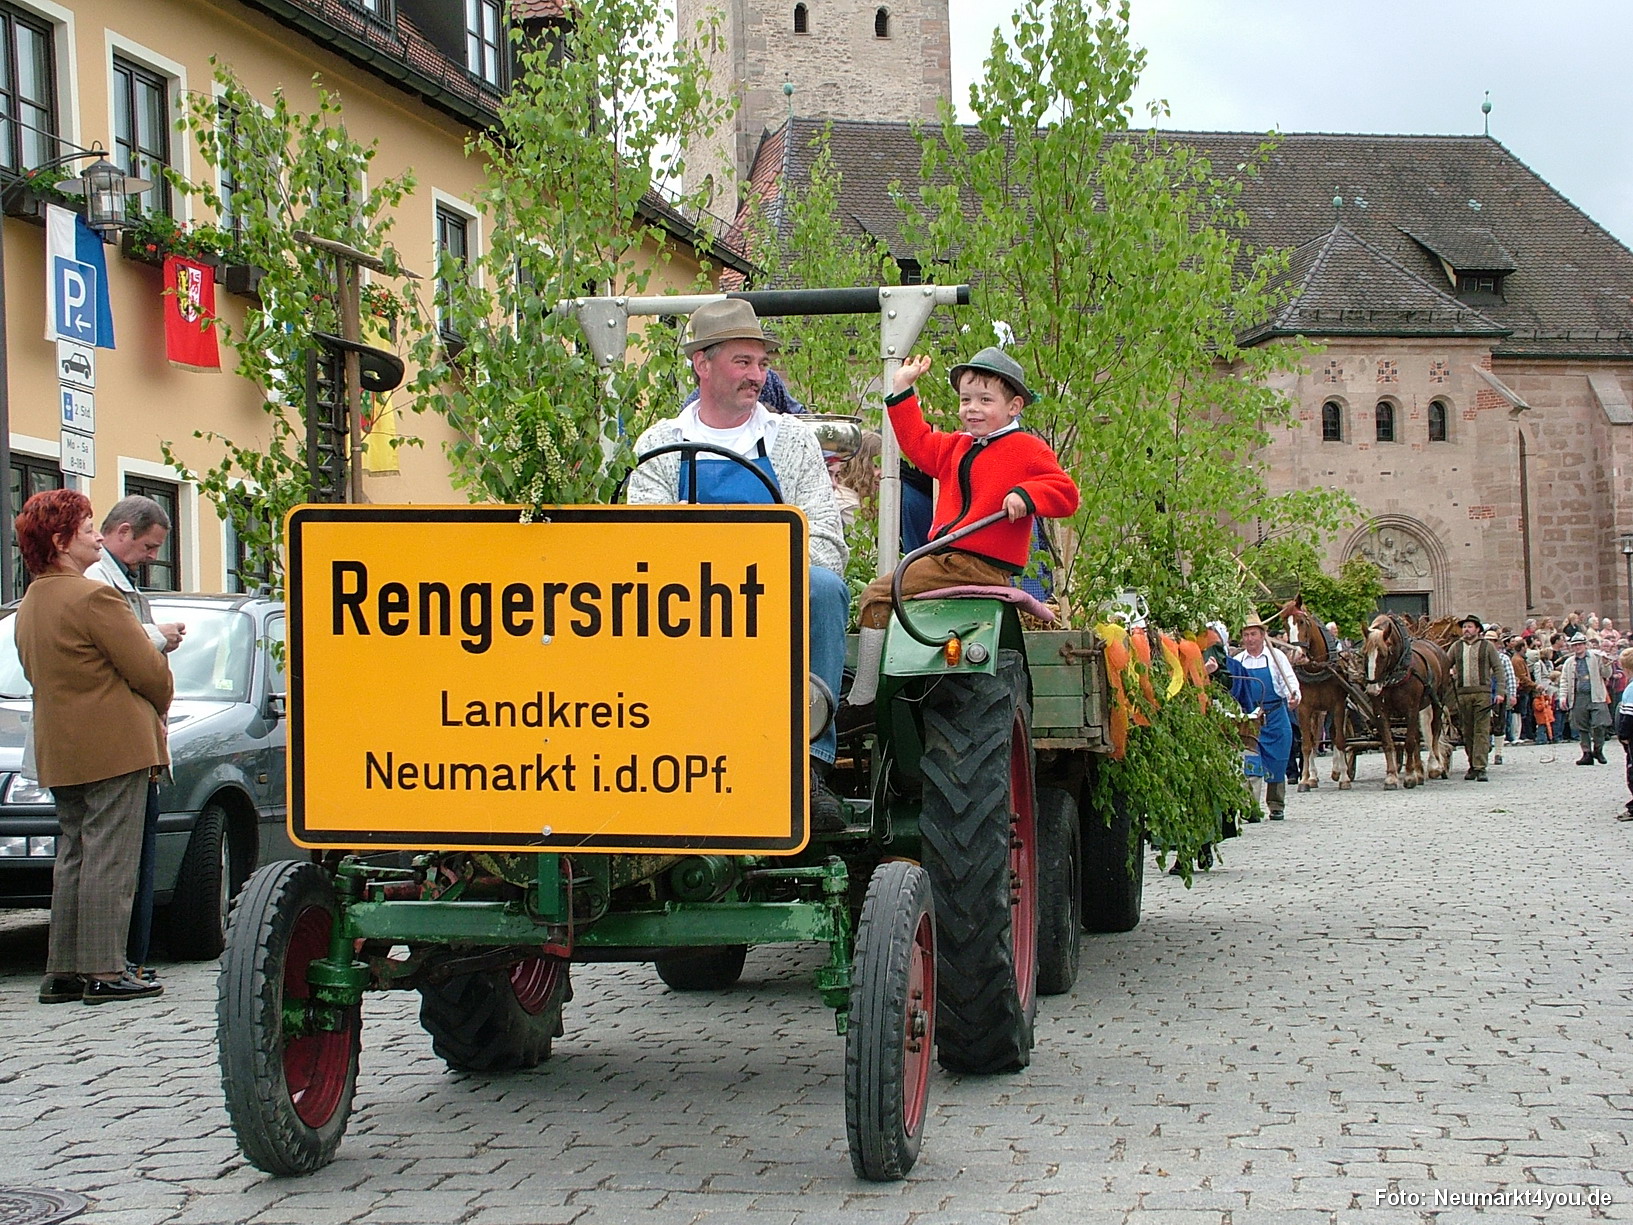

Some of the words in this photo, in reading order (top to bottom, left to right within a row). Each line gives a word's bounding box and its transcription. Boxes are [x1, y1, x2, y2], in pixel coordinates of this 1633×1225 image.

[64, 268, 86, 328] P
[74, 403, 79, 415] 2
[81, 405, 92, 418] Std.
[67, 438, 75, 450] Mo
[82, 442, 89, 454] Sa
[331, 560, 765, 655] Rengersricht
[441, 690, 650, 729] Landkreis
[365, 751, 576, 792] Neumarkt
[593, 753, 732, 794] i.d.OPf.
